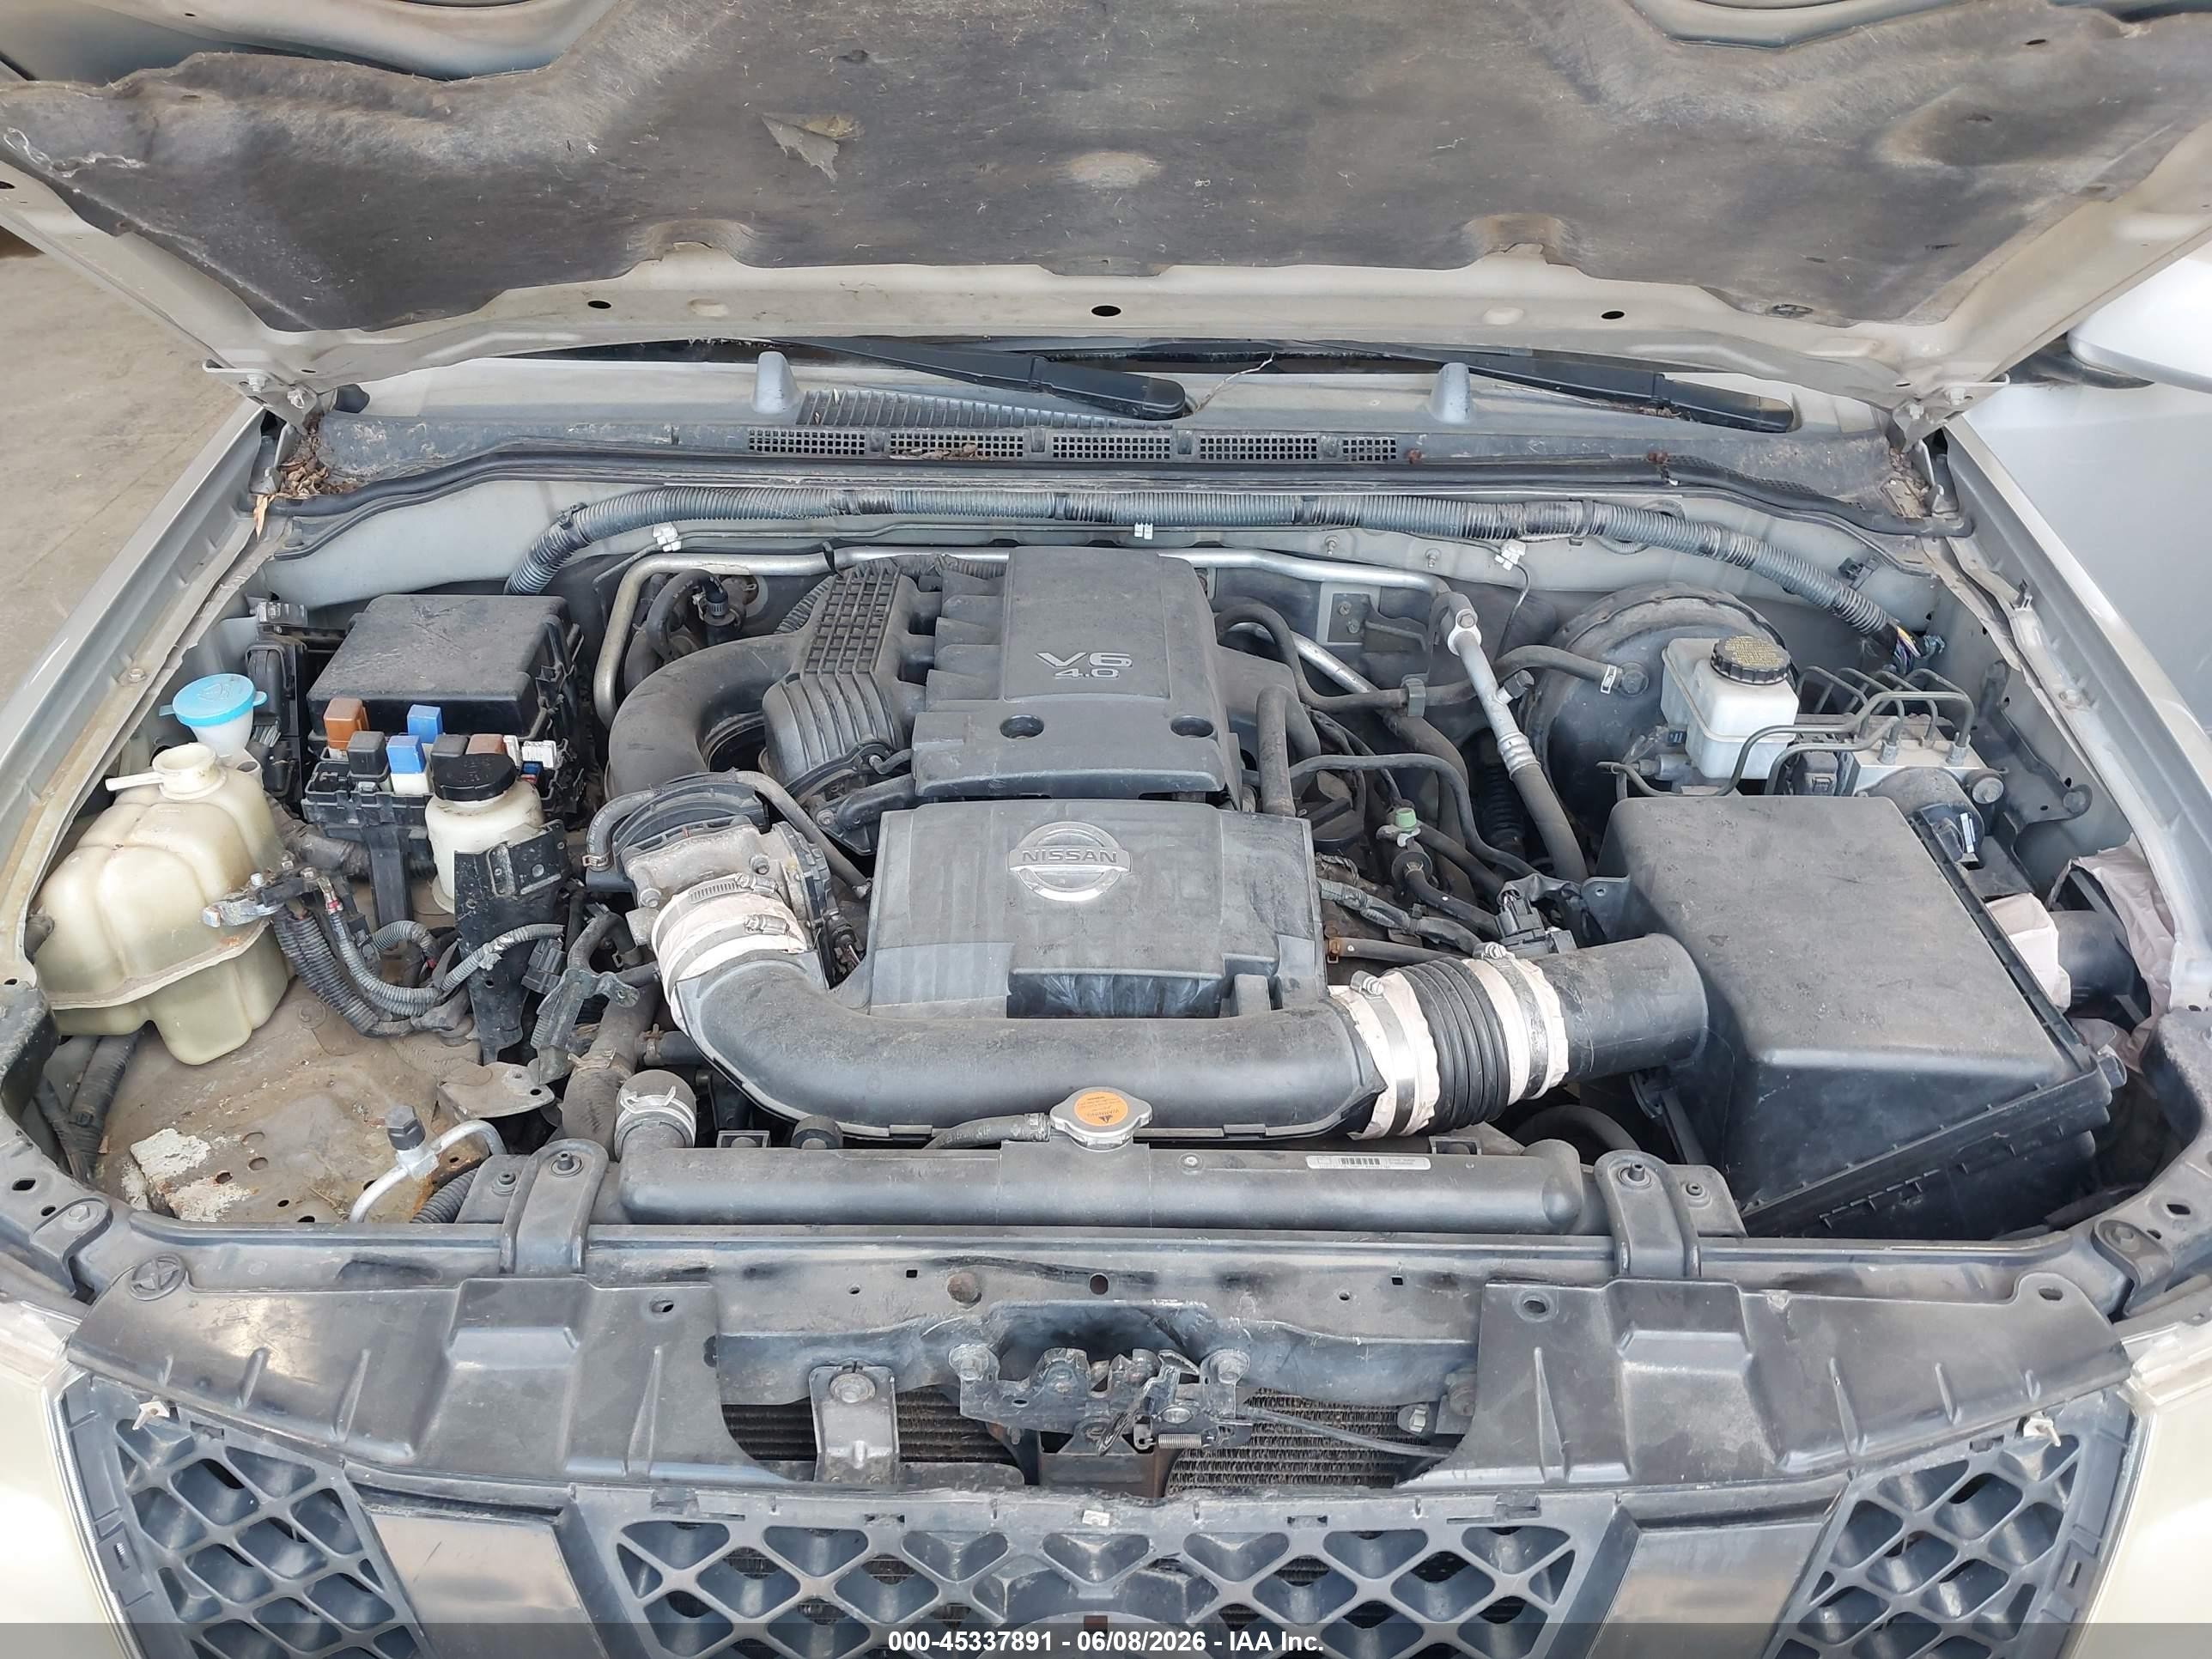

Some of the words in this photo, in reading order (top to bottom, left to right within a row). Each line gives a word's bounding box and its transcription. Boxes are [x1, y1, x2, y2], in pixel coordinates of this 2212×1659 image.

[1036, 652, 1133, 667] V6
[1054, 668, 1119, 678] 4.0
[1022, 848, 1117, 863] NISSAN
